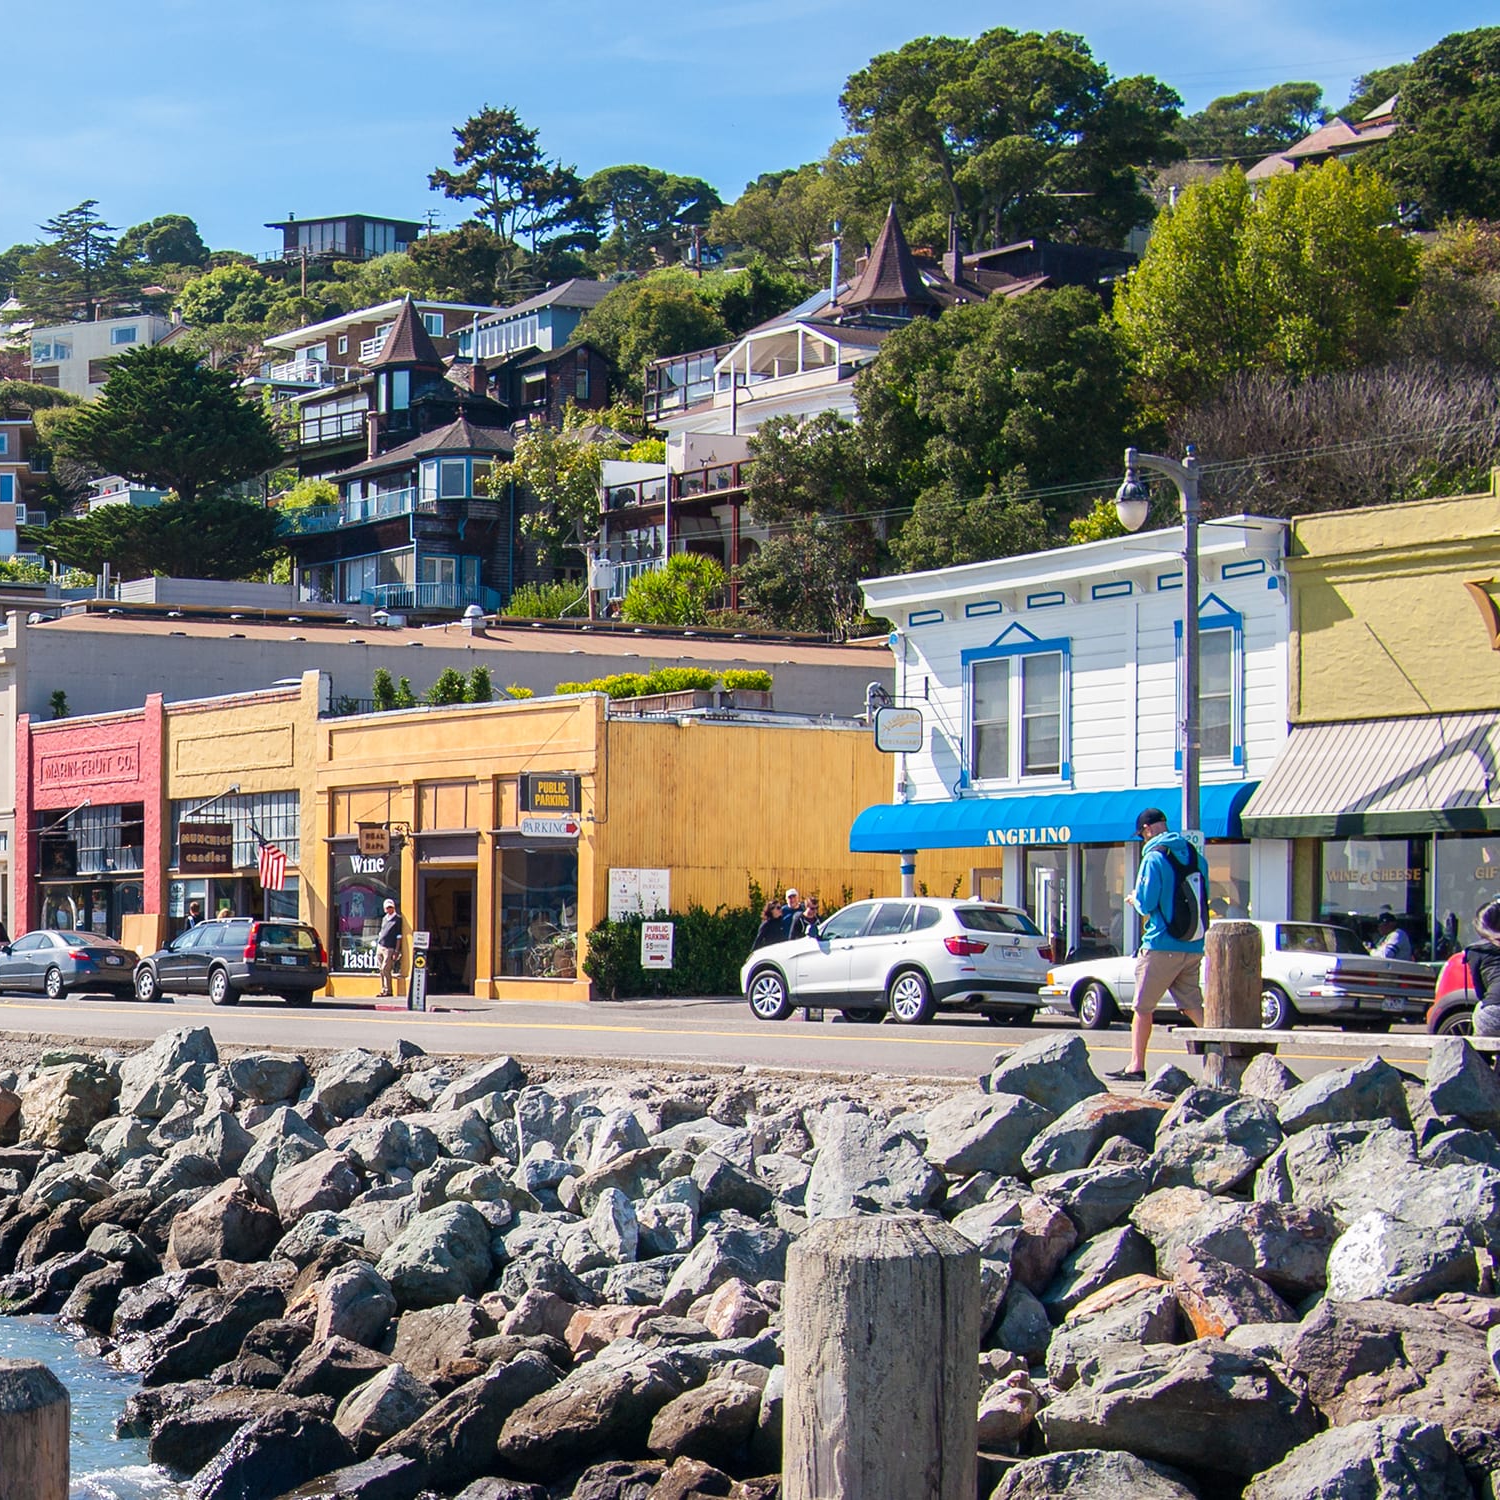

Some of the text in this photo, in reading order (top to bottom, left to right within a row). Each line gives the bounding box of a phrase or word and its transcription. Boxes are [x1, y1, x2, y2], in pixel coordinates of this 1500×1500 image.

[538, 781, 566, 794] PUBLIC
[535, 794, 570, 807] PARKING
[523, 822, 566, 833] PARKING
[181, 833, 232, 846] MUNCHIES
[984, 826, 1071, 845] ANGELINO
[350, 855, 385, 874] Wine
[1326, 869, 1358, 884] WINE
[1371, 868, 1421, 882] CHEESE
[646, 925, 669, 933] PUBLIC
[644, 933, 670, 941] PARKING
